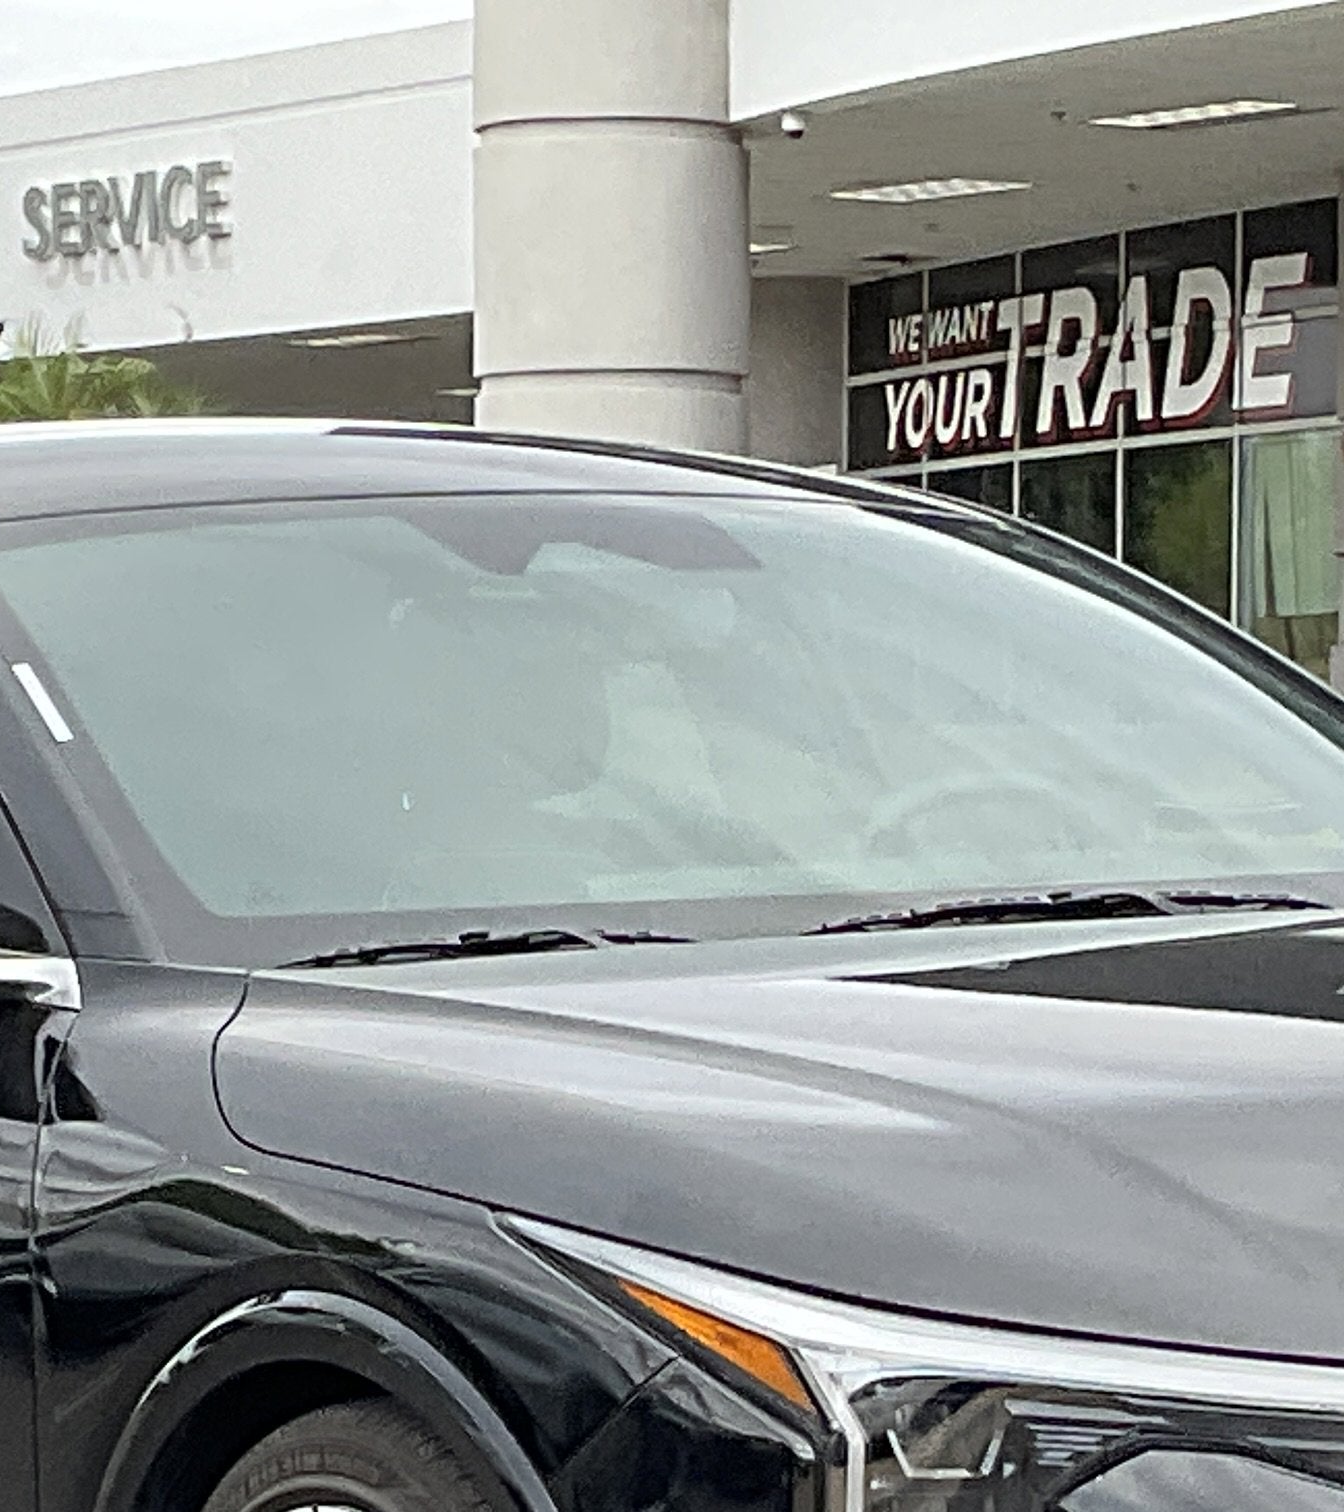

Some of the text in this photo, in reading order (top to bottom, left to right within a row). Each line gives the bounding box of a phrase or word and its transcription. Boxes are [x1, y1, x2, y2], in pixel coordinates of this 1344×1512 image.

[22, 160, 233, 263] SERVICE
[885, 252, 1308, 451] YOUR TRADE
[889, 300, 995, 355] WE WANT
